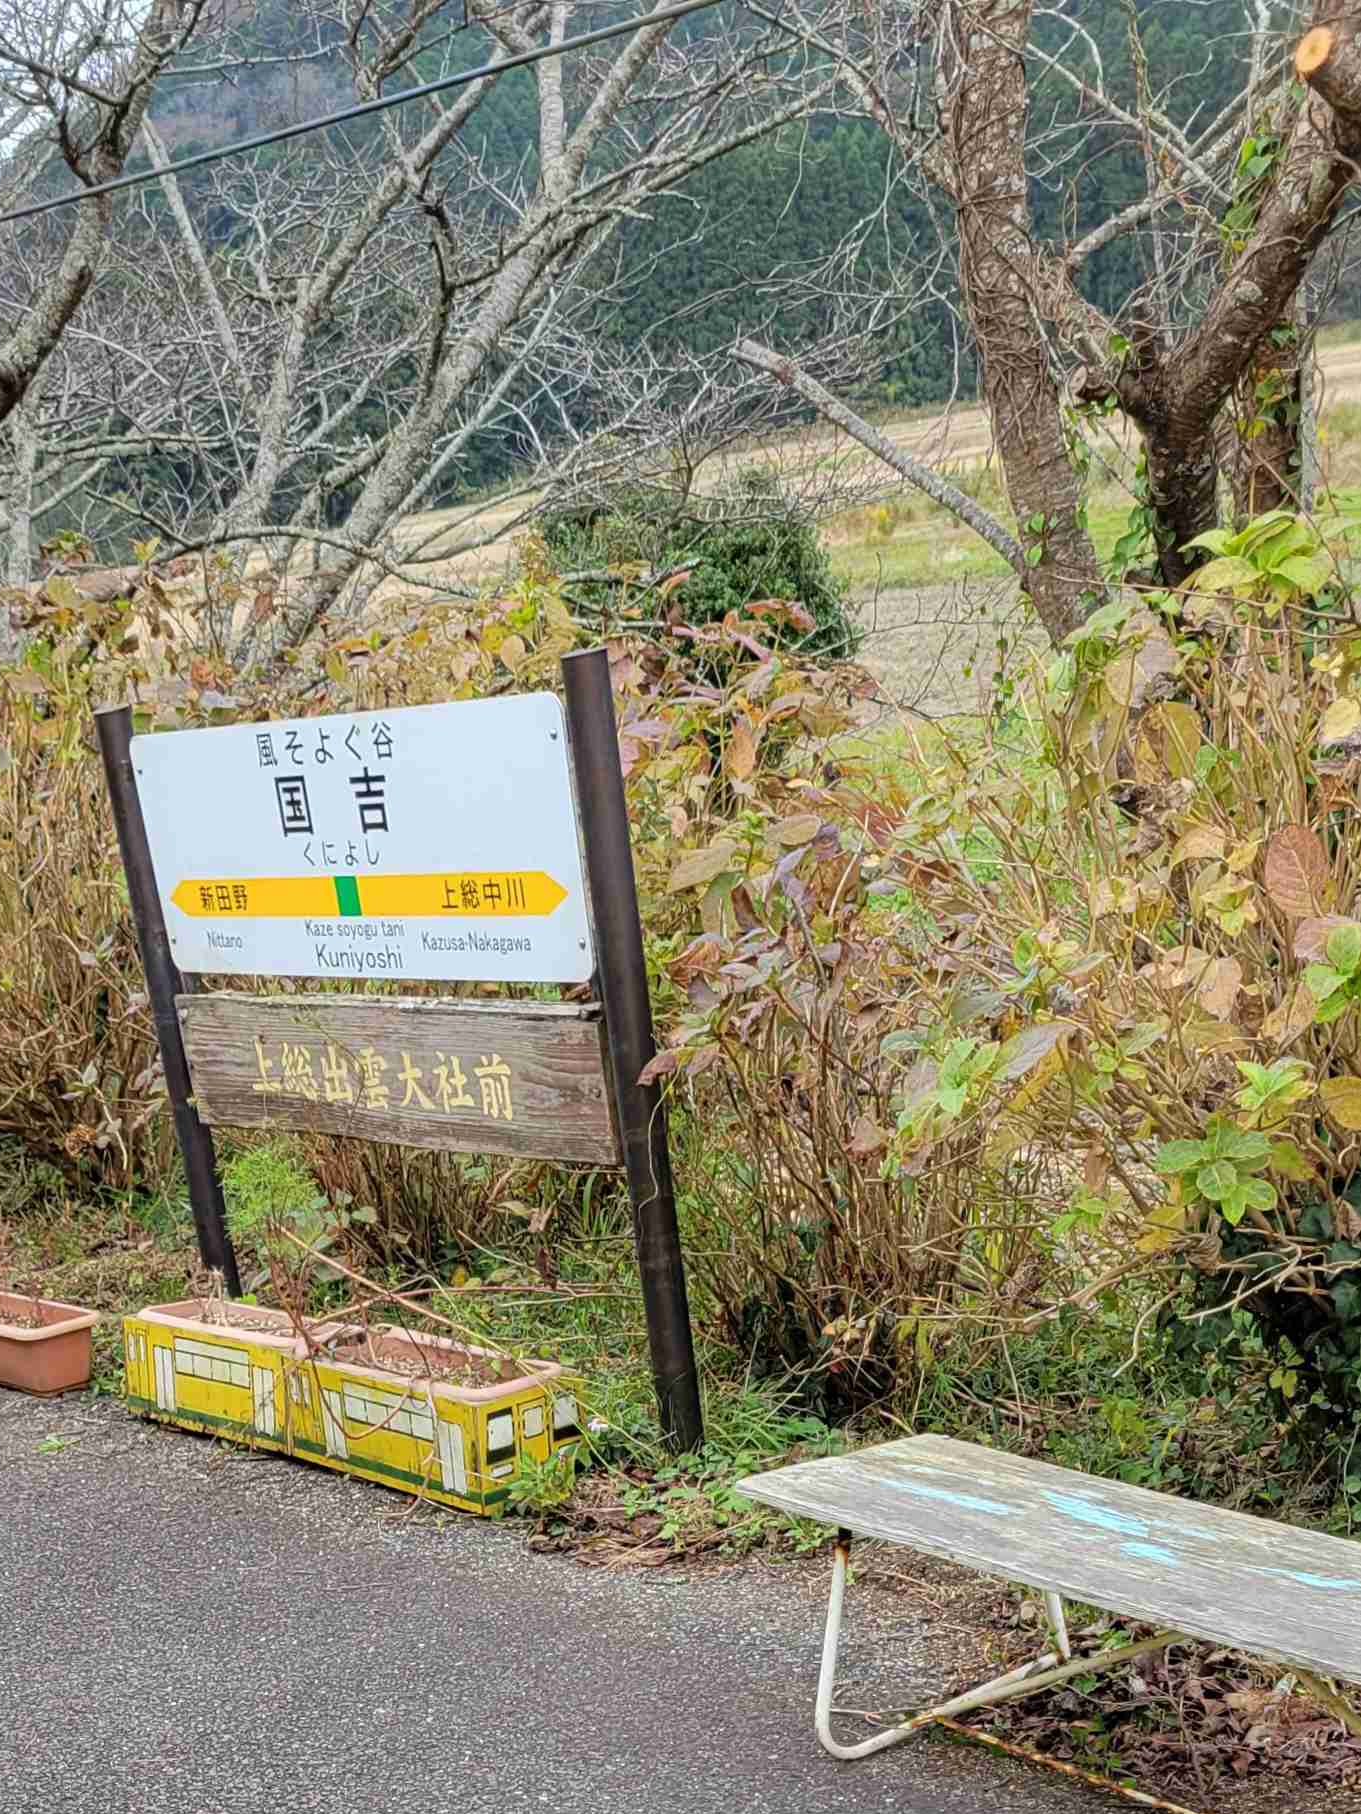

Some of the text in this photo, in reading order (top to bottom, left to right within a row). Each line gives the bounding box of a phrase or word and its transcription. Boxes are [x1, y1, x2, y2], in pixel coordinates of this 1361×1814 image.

[256, 722, 393, 768] 風そよぐ谷
[274, 766, 389, 837] 国吉
[303, 839, 380, 866] くによし
[441, 877, 526, 910] 上総中川
[305, 920, 405, 940] Kaze soyogu tani
[421, 930, 532, 955] Kazusa-Nakagawa
[315, 944, 404, 972] Kuniyoshi
[252, 1036, 513, 1121] 上総出雲大社前
